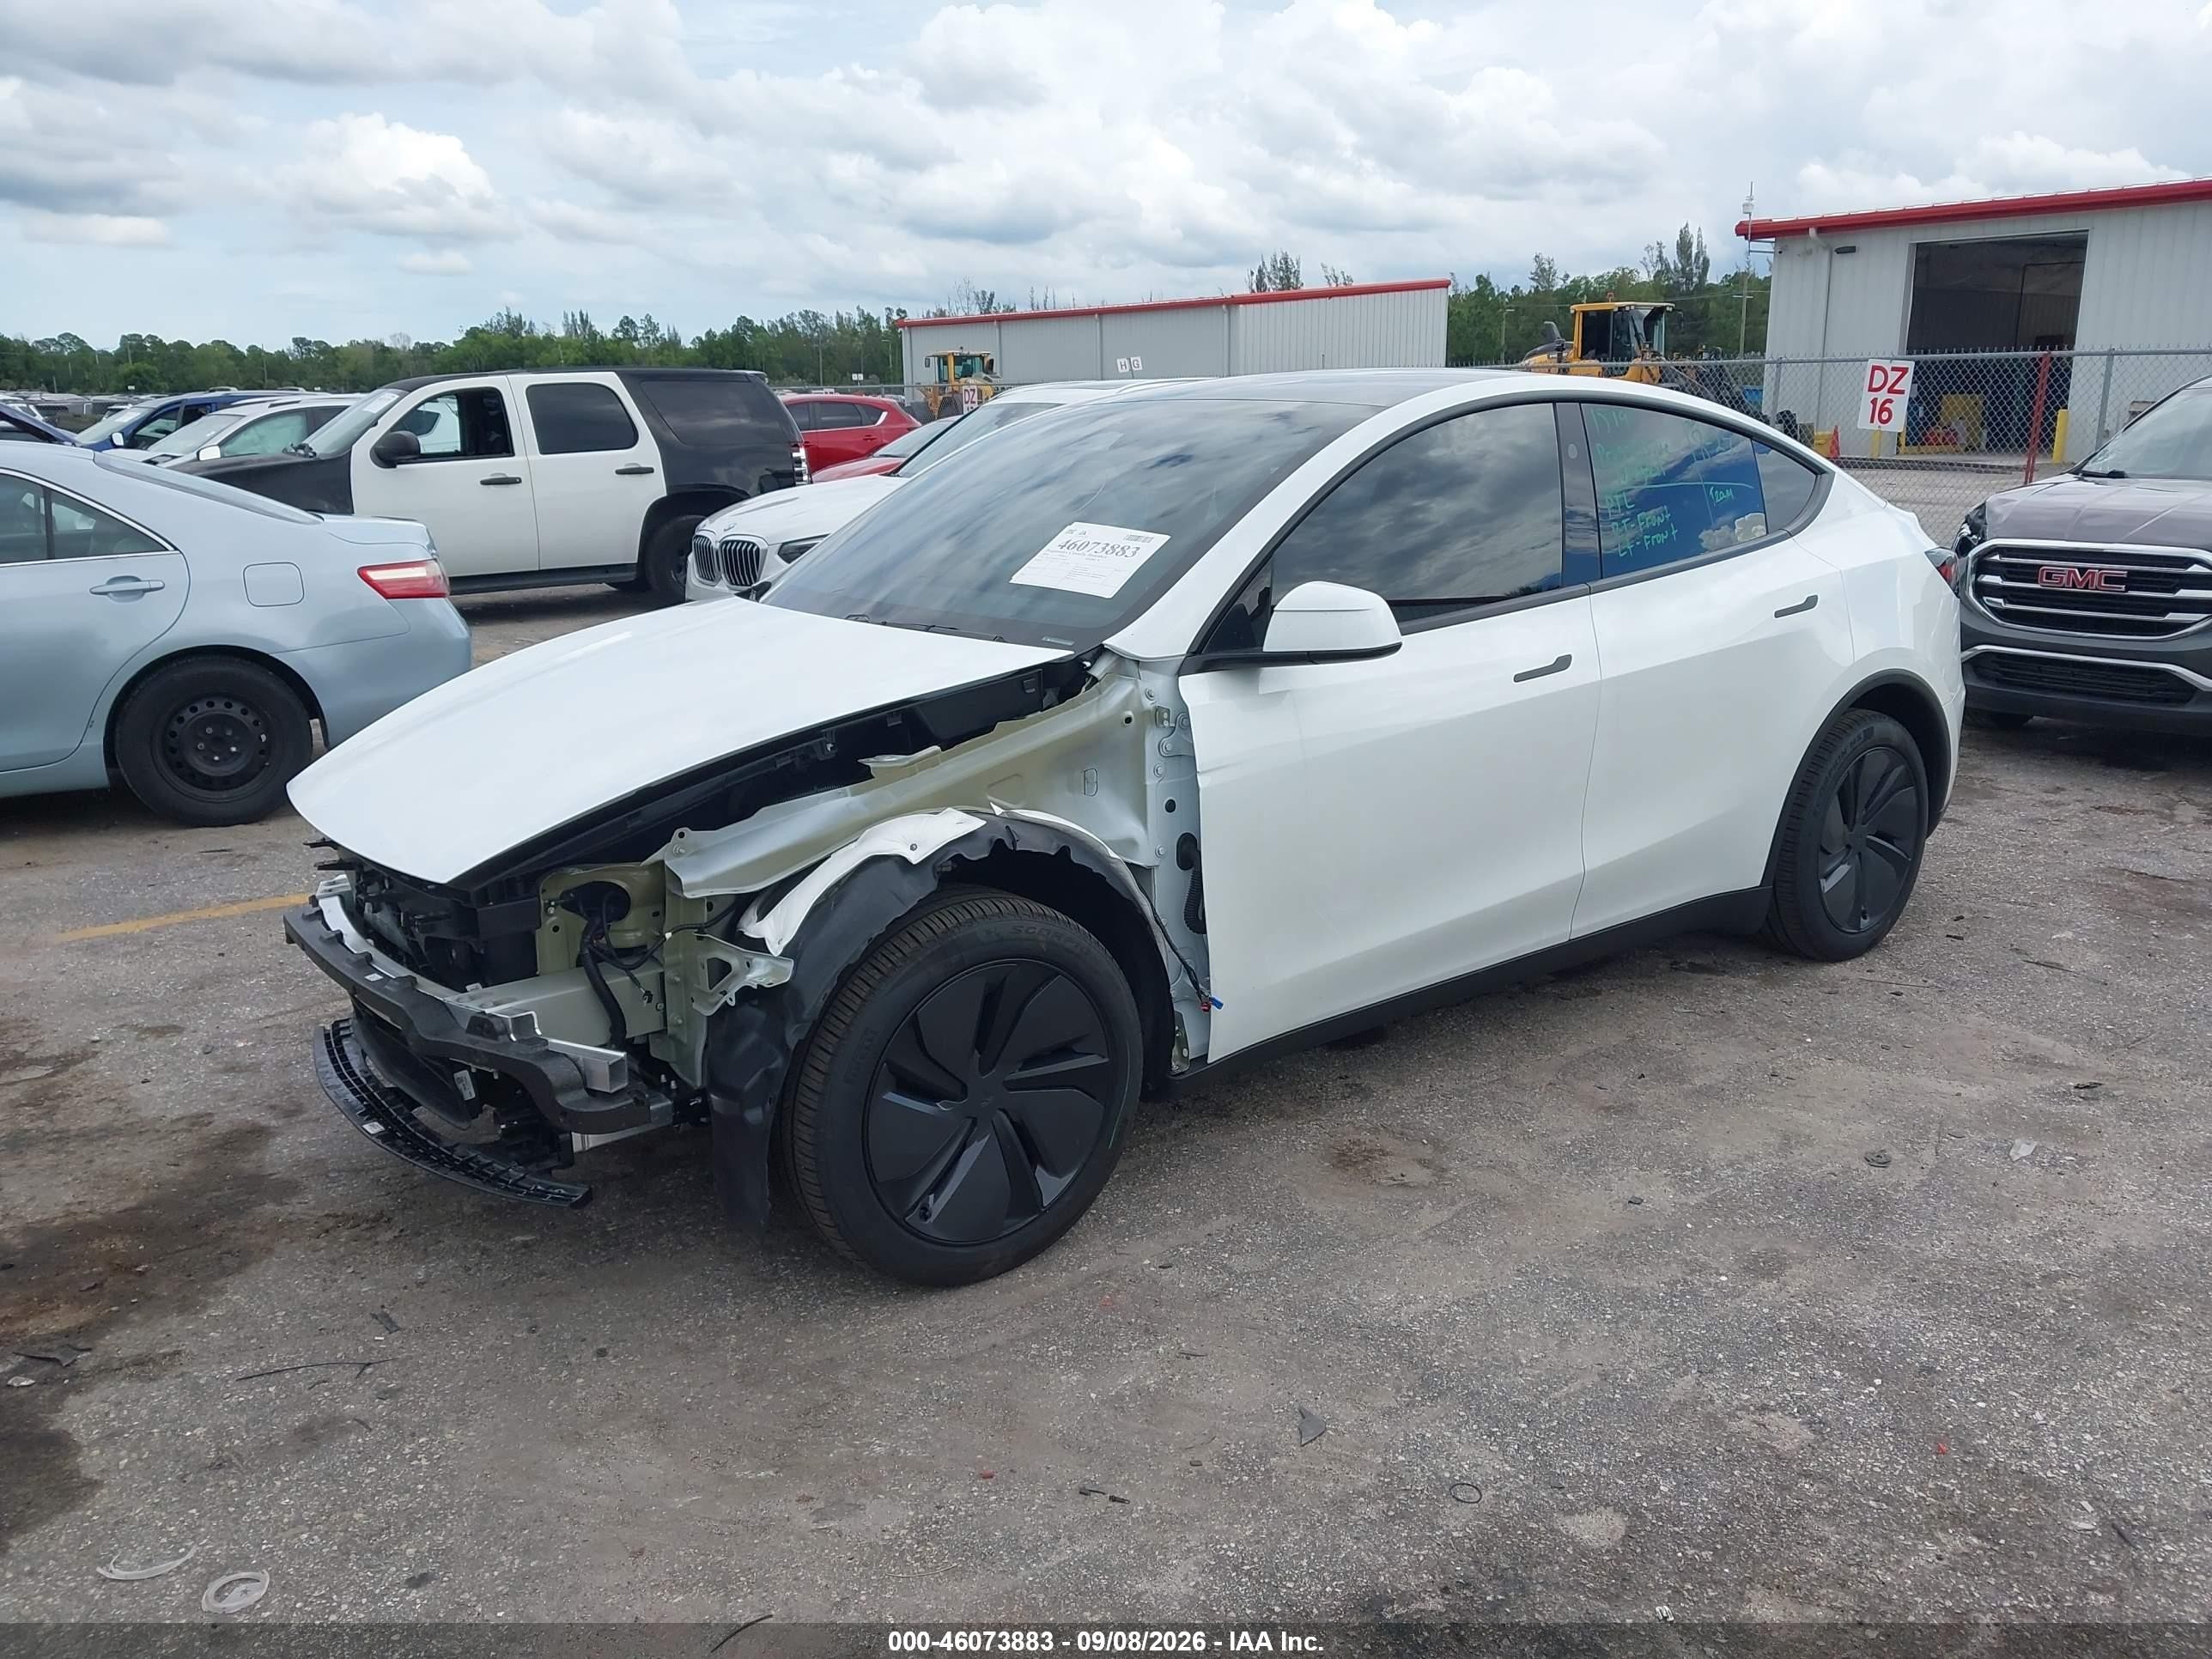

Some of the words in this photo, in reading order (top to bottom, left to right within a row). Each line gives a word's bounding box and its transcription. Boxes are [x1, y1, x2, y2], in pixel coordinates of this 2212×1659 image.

[1120, 361, 1127, 370] H
[1133, 359, 1140, 369] G
[1868, 365, 1909, 395] DZ
[963, 388, 976, 404] DZ
[1869, 398, 1894, 424] 16
[1058, 538, 1140, 558] 46073883
[2038, 566, 2128, 591] GMC
